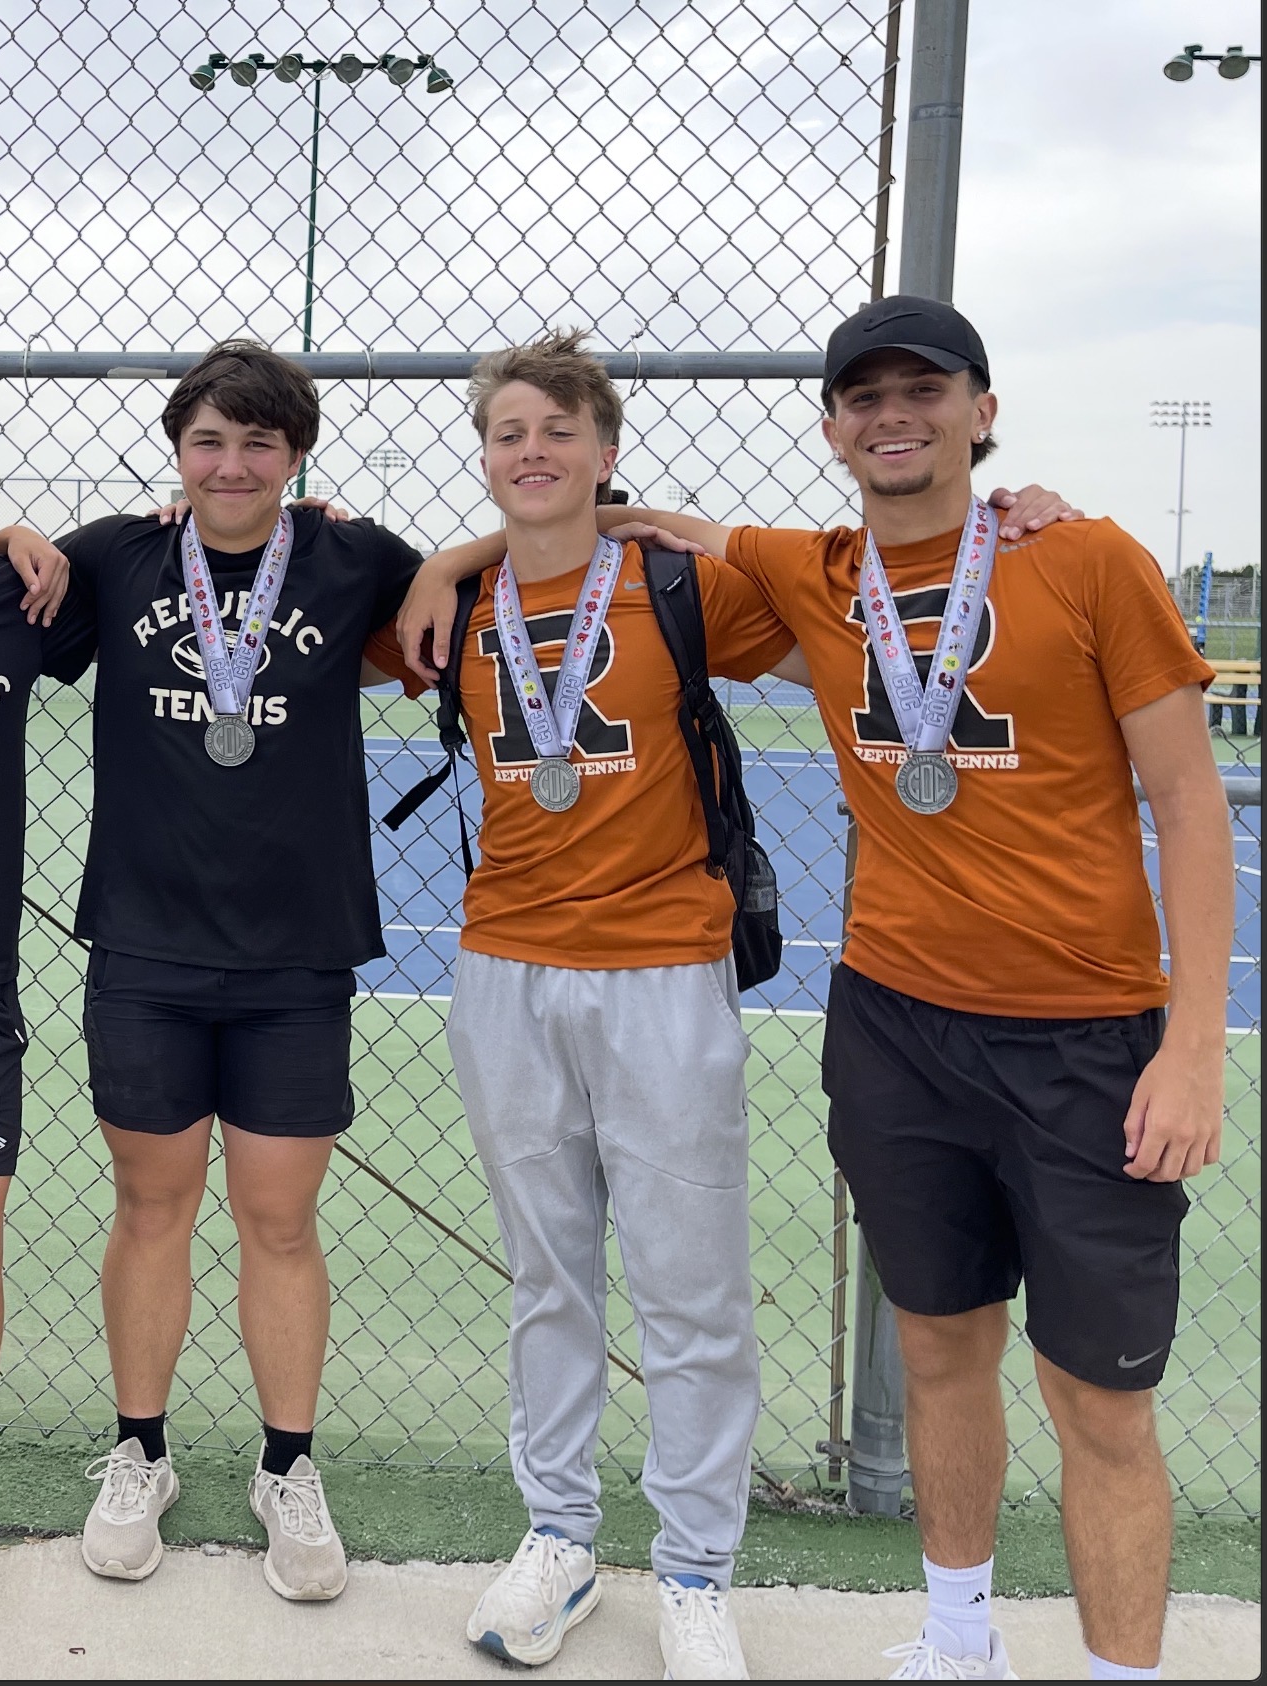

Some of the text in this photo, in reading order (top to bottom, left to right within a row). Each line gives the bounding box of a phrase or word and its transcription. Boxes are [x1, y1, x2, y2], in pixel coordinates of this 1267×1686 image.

[210, 657, 231, 692] COC
[233, 646, 255, 680] COC
[845, 583, 1015, 751] R
[477, 609, 633, 768] R
[559, 674, 582, 709] COC
[892, 672, 921, 711] COC
[149, 688, 287, 726] TENIS
[925, 688, 952, 728] COC
[573, 757, 637, 777] TENNIS
[943, 753, 1019, 770] TENNIS
[539, 767, 571, 802] COC
[908, 763, 946, 803] COC
